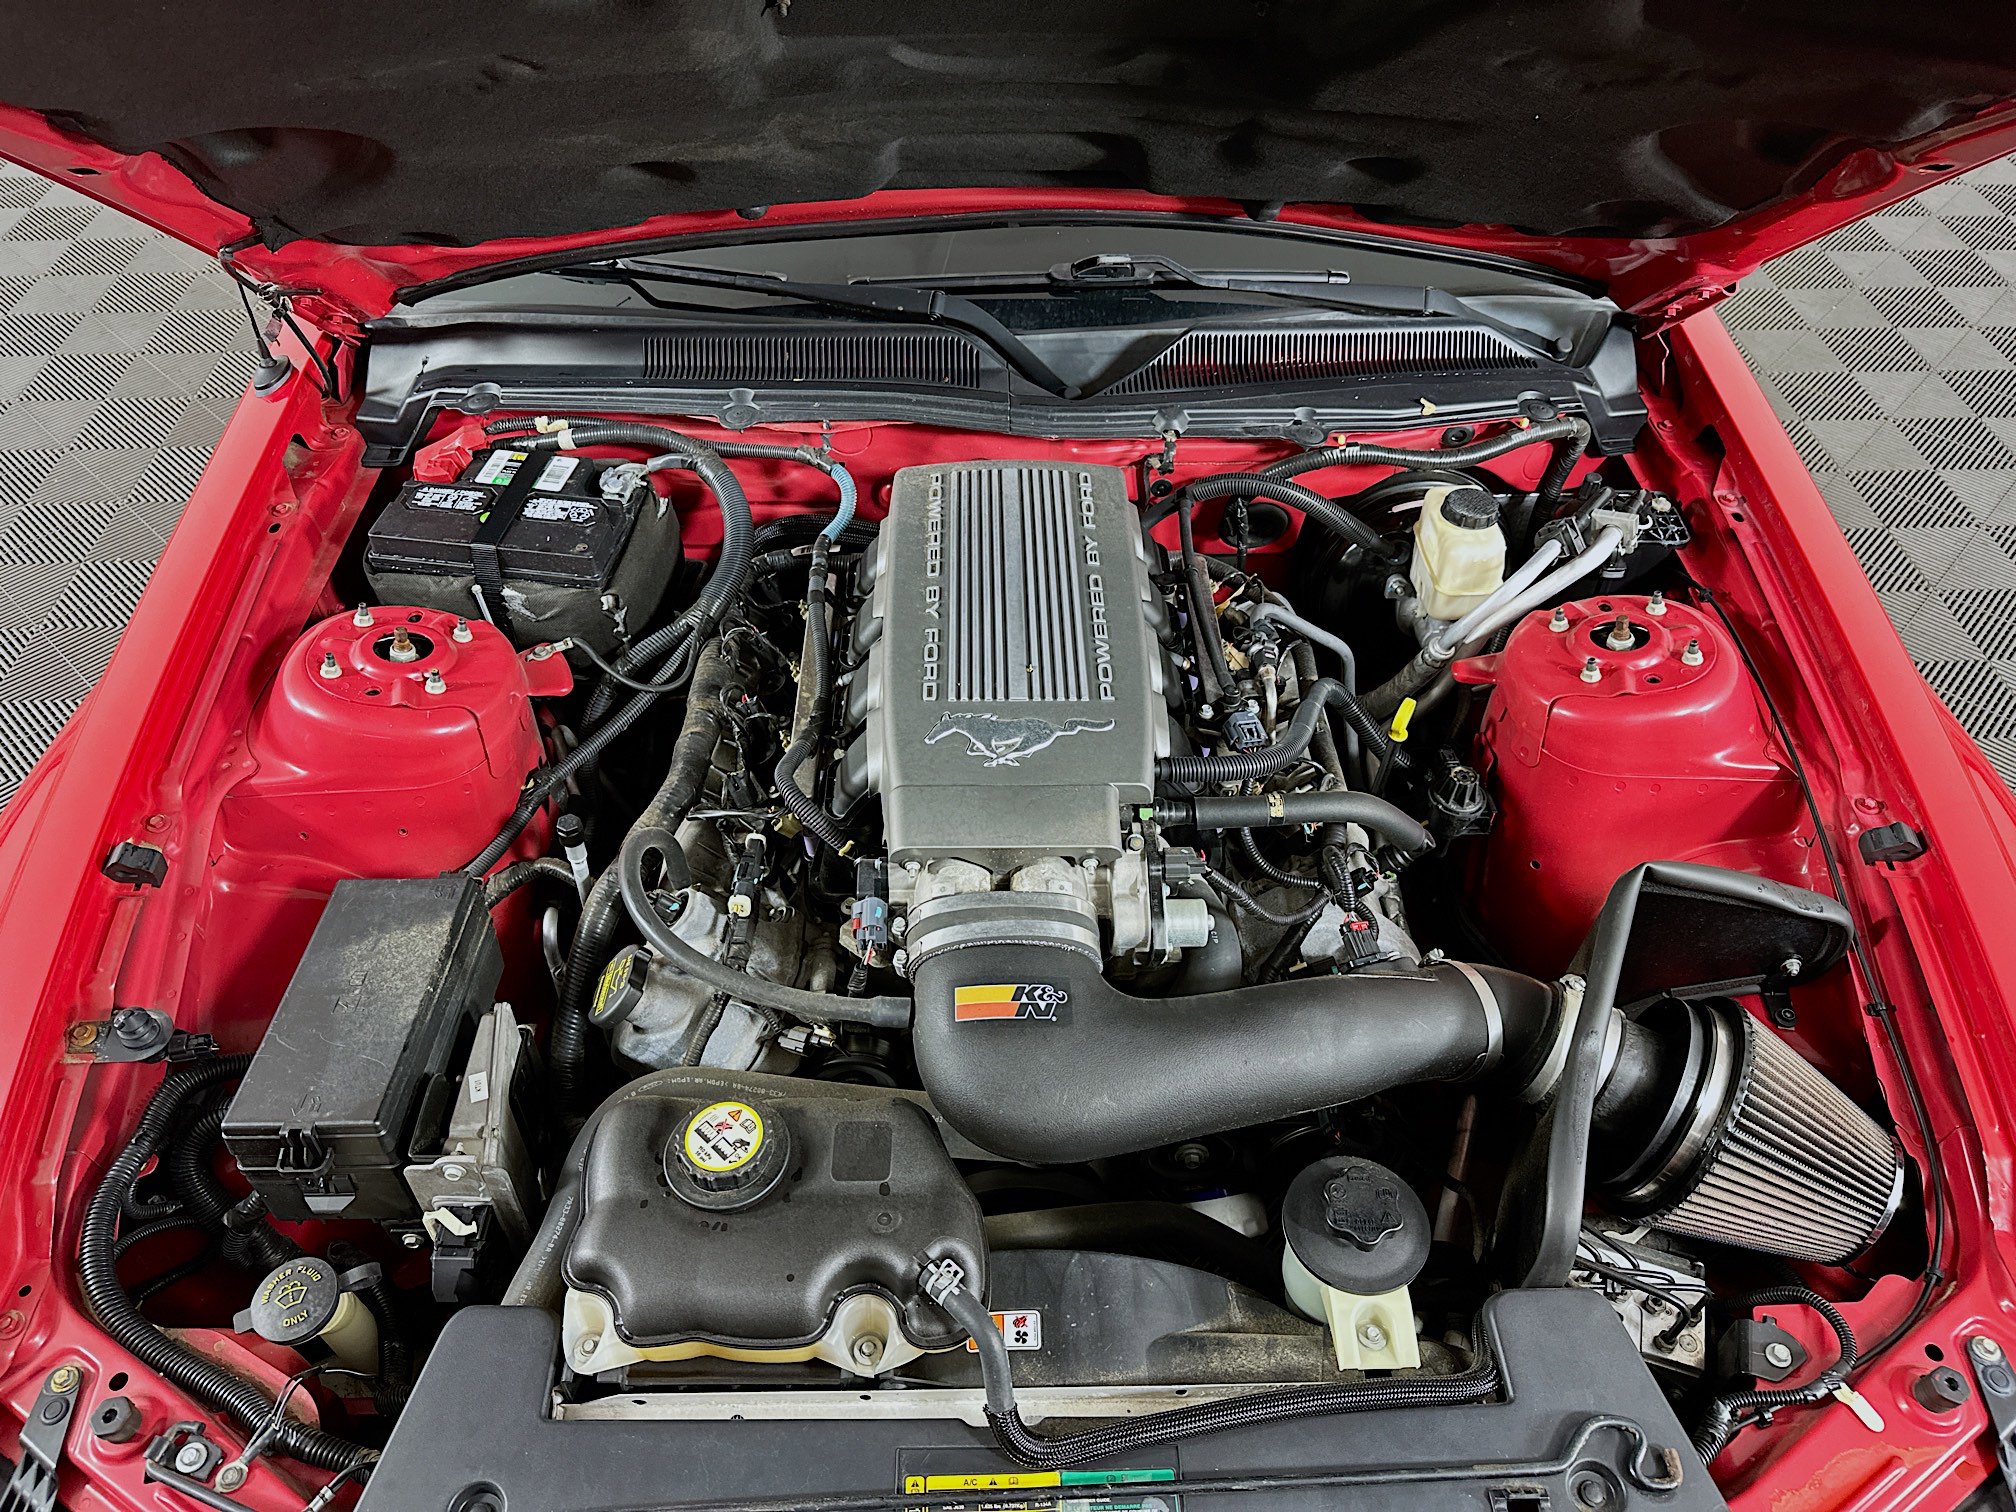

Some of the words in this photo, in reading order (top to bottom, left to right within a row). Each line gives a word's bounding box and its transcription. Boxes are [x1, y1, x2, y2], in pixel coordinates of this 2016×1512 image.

[1078, 472, 1096, 530] FORD
[927, 473, 941, 577] POWERED
[1083, 535, 1101, 565] BY
[925, 585, 940, 619] BY
[1089, 574, 1115, 700] POWERED
[922, 627, 939, 701] FORD
[261, 1268, 293, 1305] WASHER
[297, 1265, 322, 1282] FLUID
[282, 1310, 309, 1327] ONLY
[963, 1478, 978, 1486] A/C
